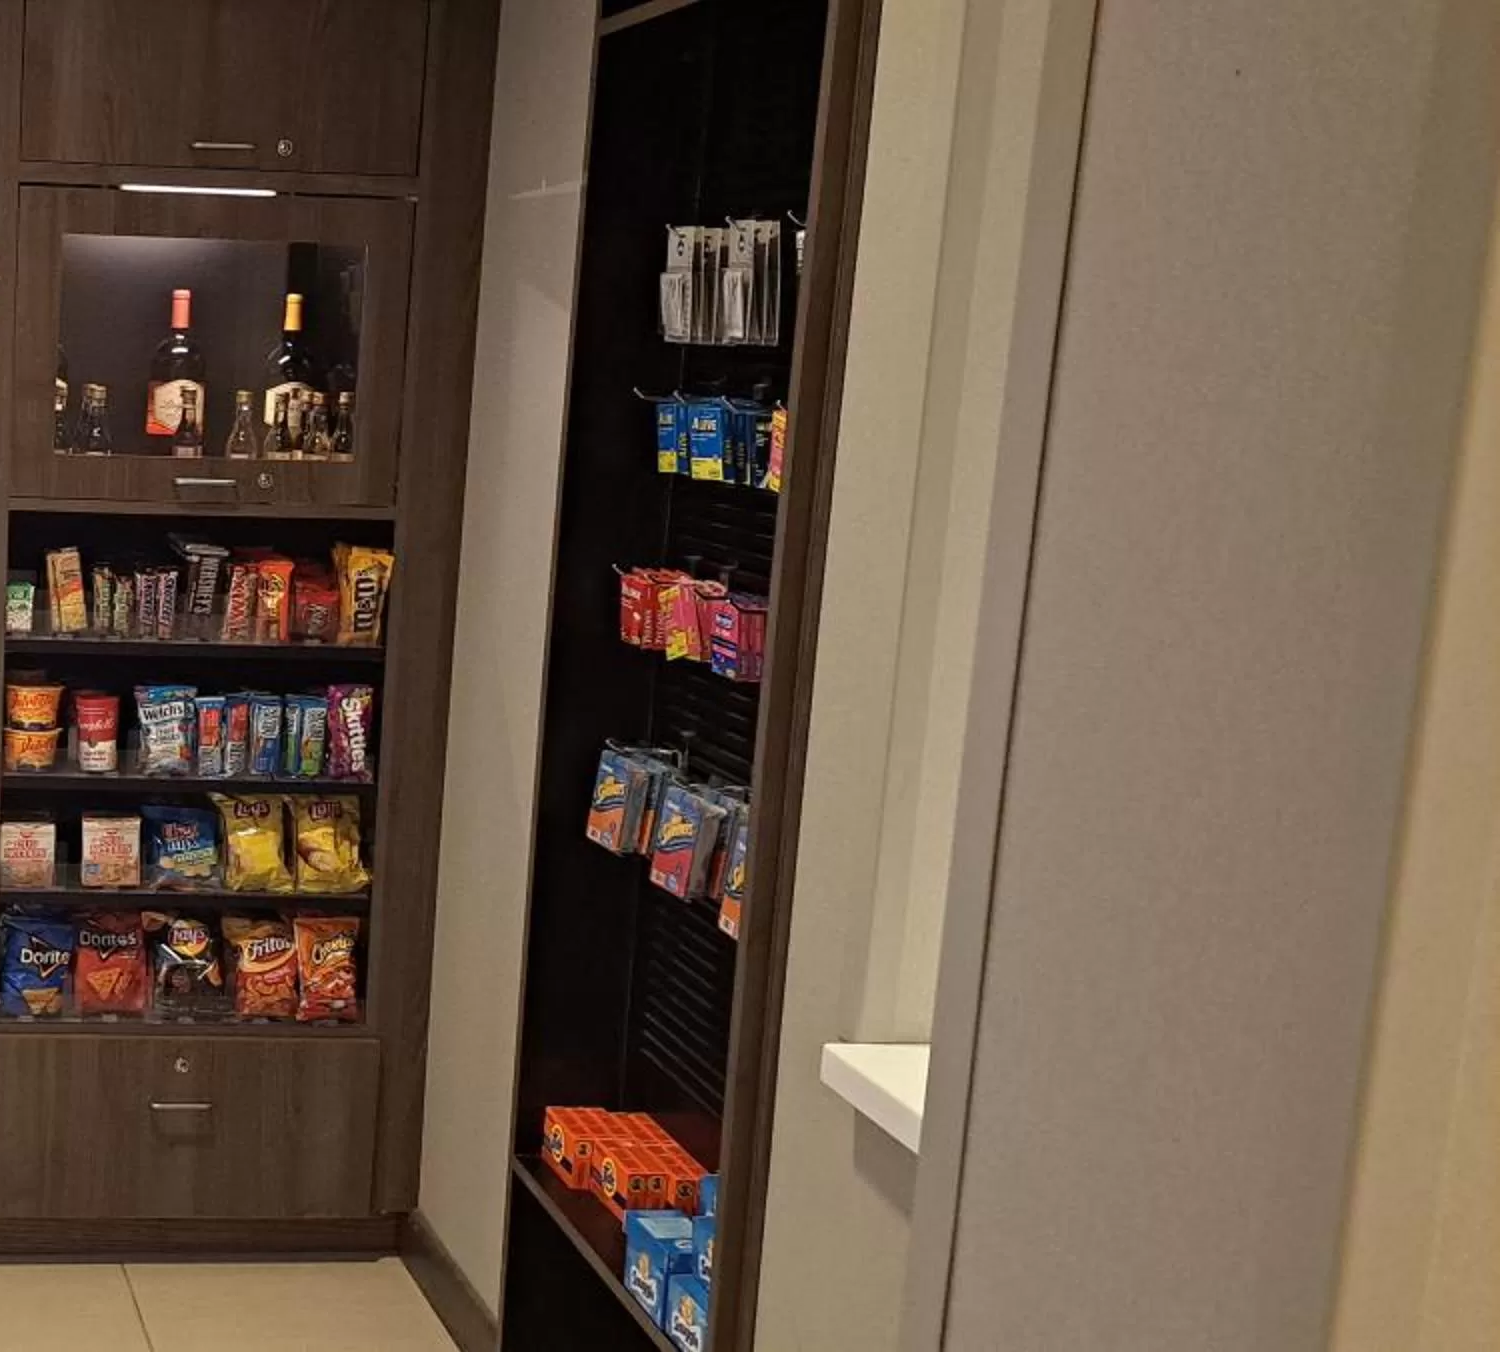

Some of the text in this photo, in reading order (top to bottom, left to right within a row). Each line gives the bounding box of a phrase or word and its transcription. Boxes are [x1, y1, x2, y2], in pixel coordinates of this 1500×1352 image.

[143, 704, 183, 721] Welch's
[342, 699, 367, 771] Skittles
[79, 930, 137, 947] Doritos
[20, 948, 70, 965] Dorito
